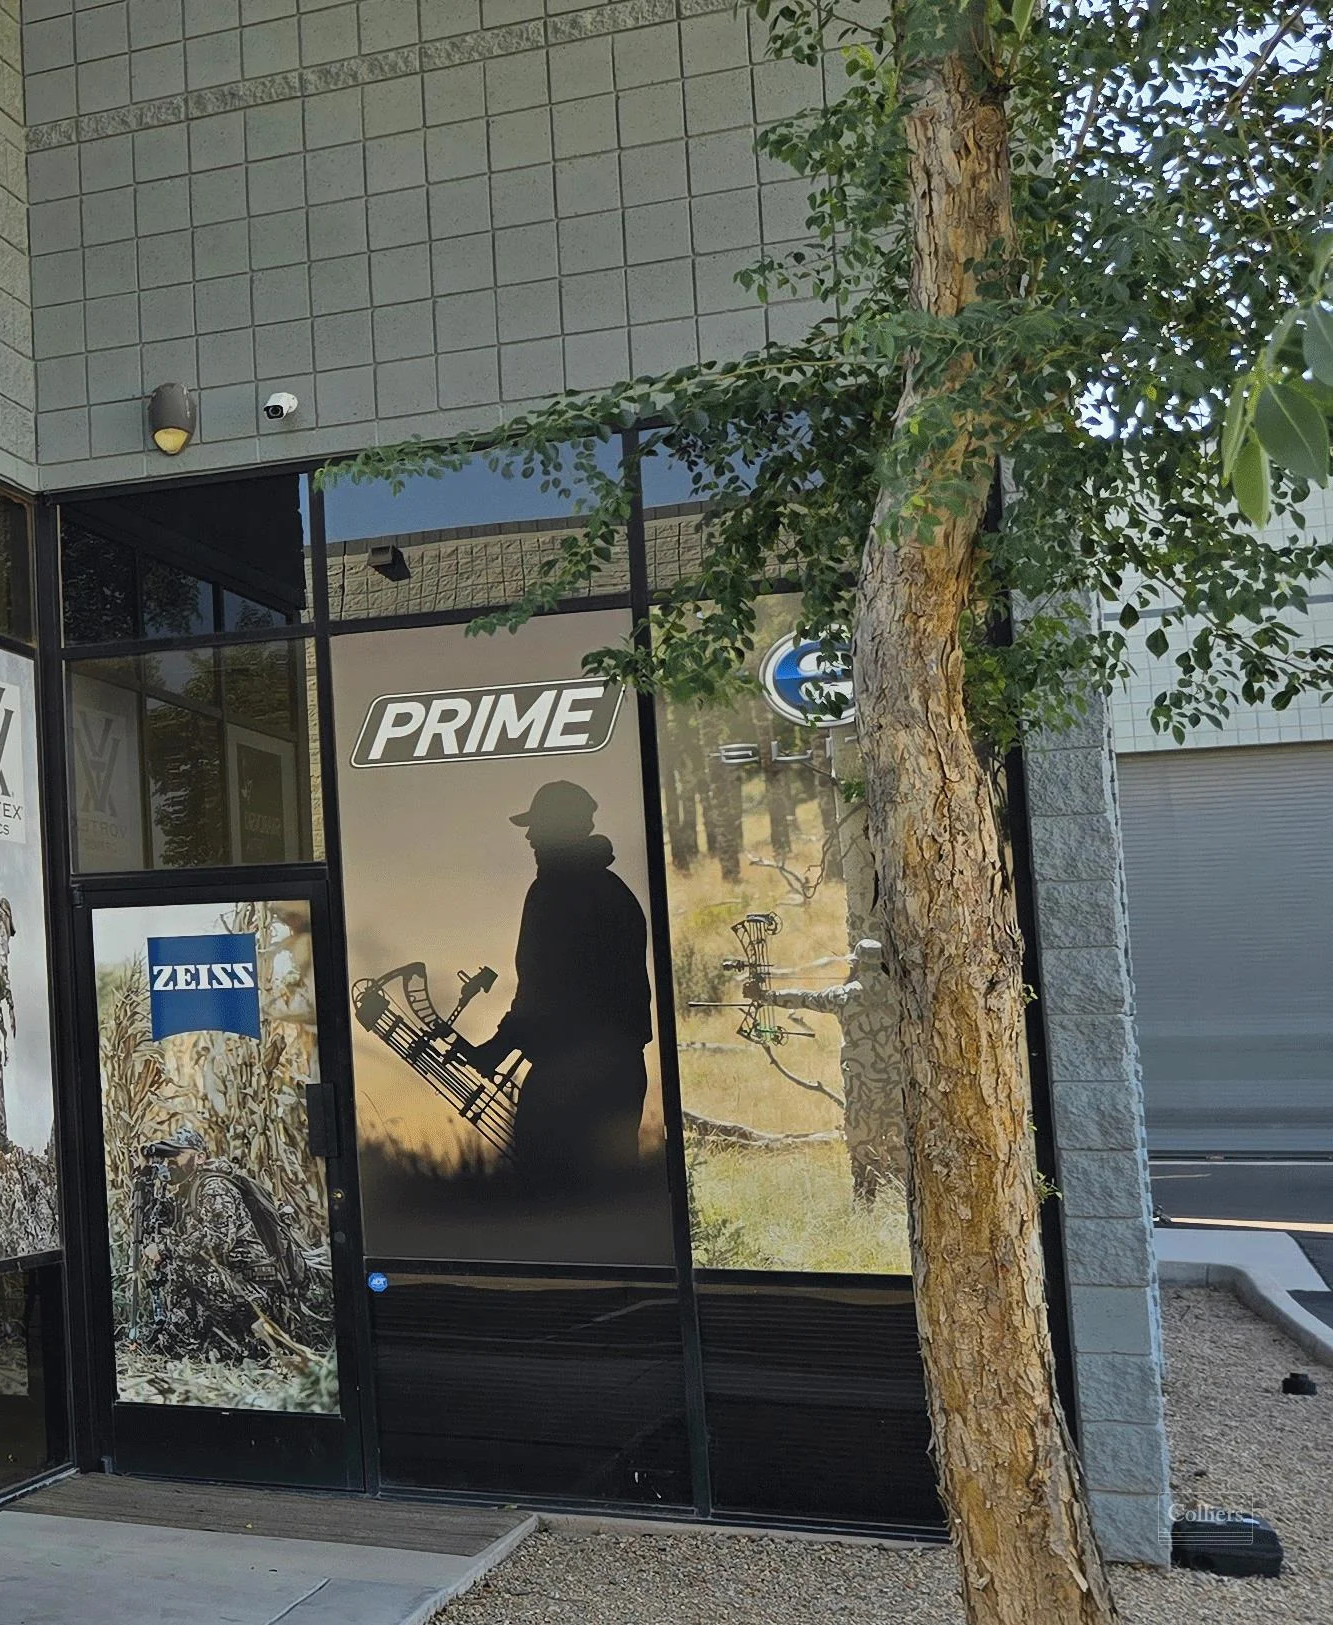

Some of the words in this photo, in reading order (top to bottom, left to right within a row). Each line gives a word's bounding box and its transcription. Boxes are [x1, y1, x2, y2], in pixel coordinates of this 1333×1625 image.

[368, 687, 604, 760] PRIME
[710, 736, 858, 763] ELI
[153, 963, 254, 991] ZEISS
